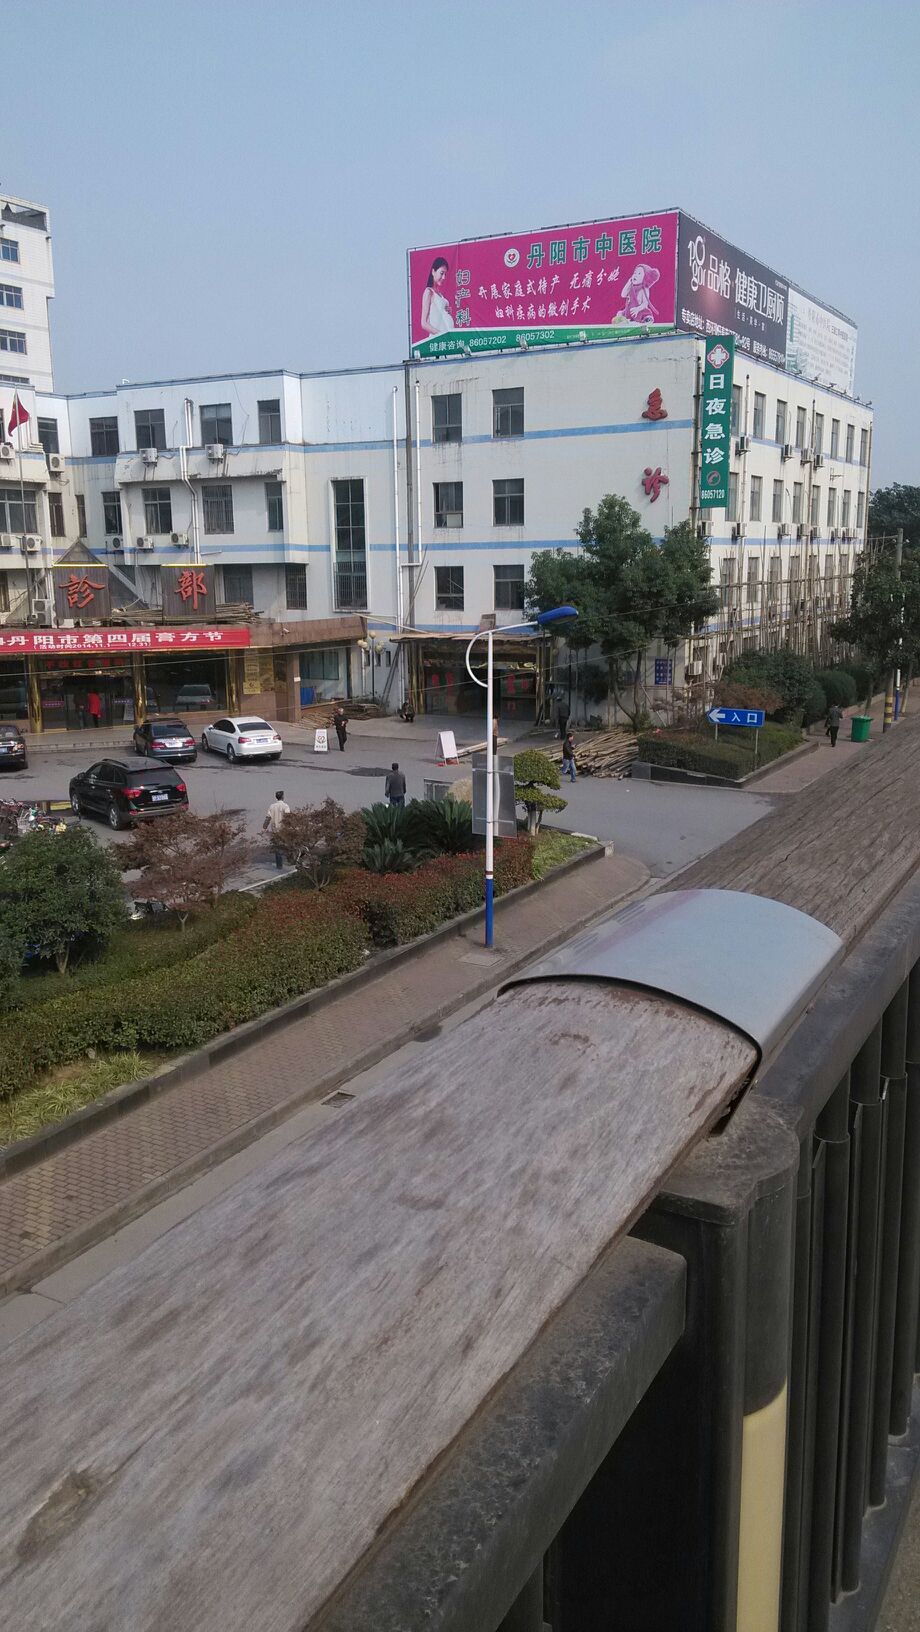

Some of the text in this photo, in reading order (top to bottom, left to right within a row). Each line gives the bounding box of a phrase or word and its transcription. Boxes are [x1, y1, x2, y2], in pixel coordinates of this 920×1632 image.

[527, 226, 663, 269] 丹阳市中医院
[708, 254, 731, 299] 品格
[455, 269, 471, 327] 妇产科
[429, 340, 465, 352] 健康咨询
[469, 335, 507, 347] 86057202
[703, 373, 726, 465] 日夜急诊
[701, 489, 725, 499] 86057120
[0, 631, 224, 646] 丹阳市第四届膏方节
[731, 712, 758, 723] 入口
